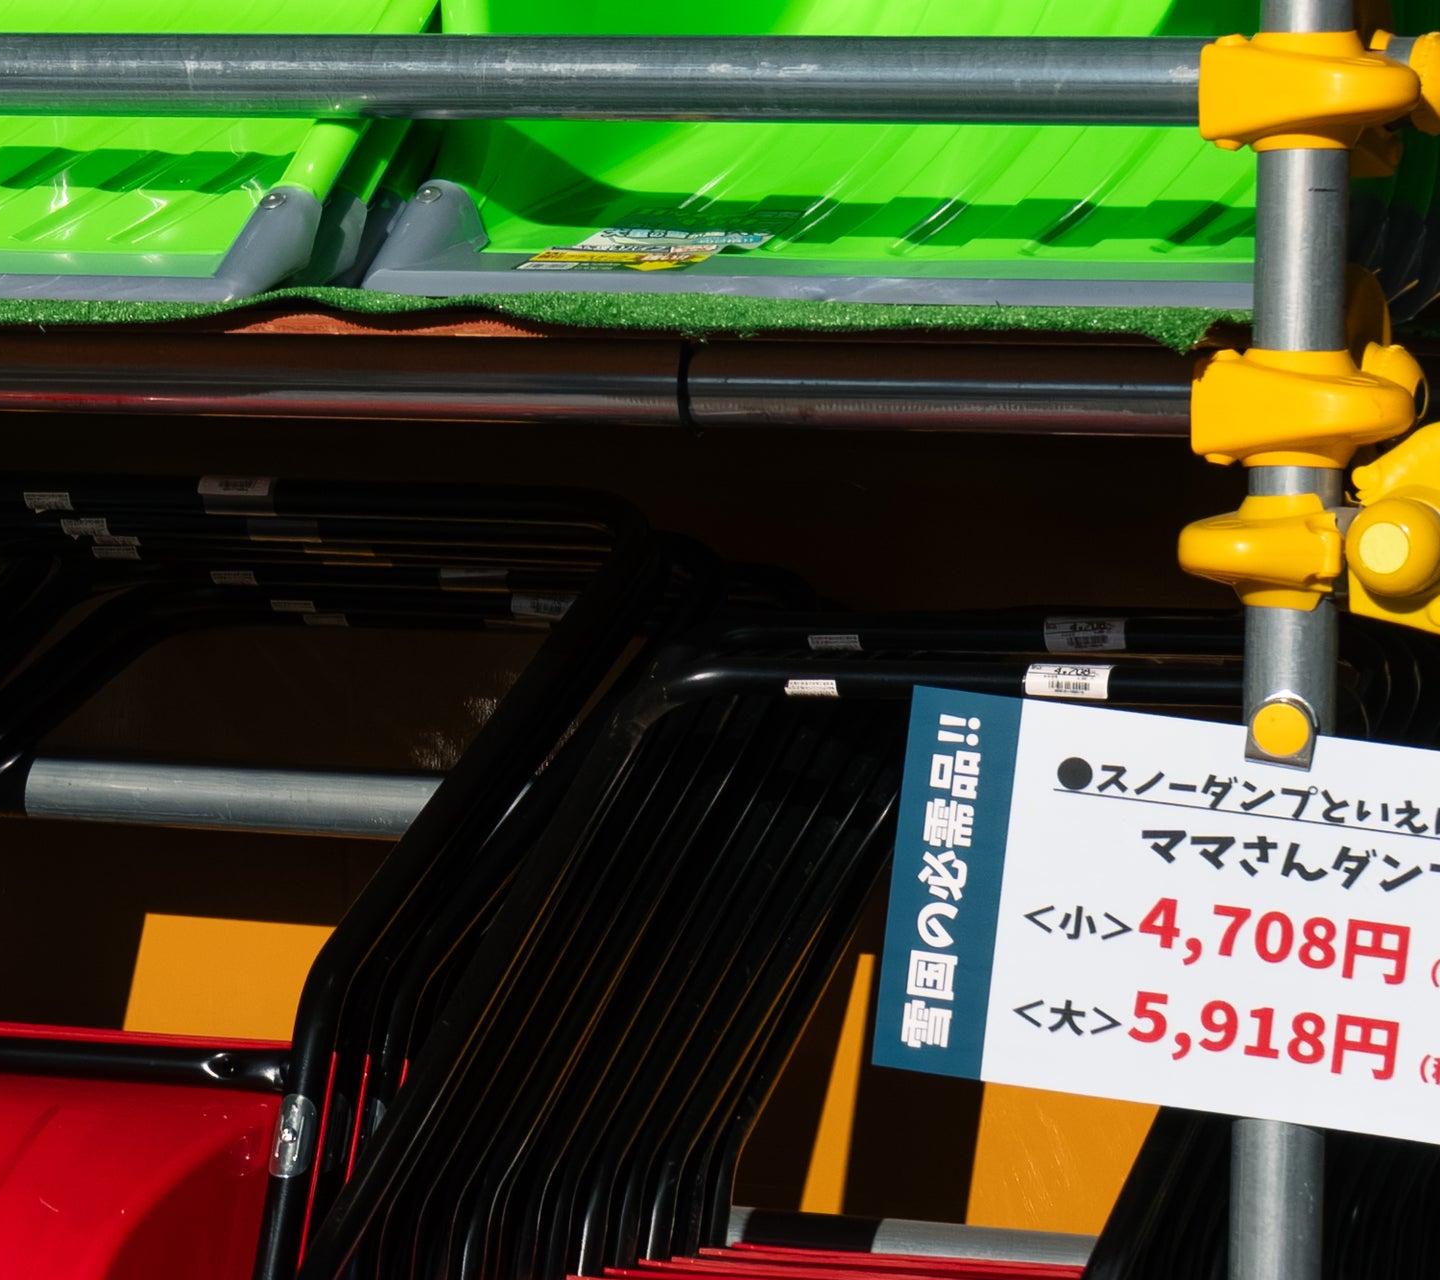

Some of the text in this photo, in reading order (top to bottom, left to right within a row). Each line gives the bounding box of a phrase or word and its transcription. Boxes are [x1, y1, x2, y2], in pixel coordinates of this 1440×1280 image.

[900, 713, 982, 1049] 雪国の必需品!!
[1138, 897, 1412, 986] 4,708円
[1127, 990, 1400, 1081] 5,918円
